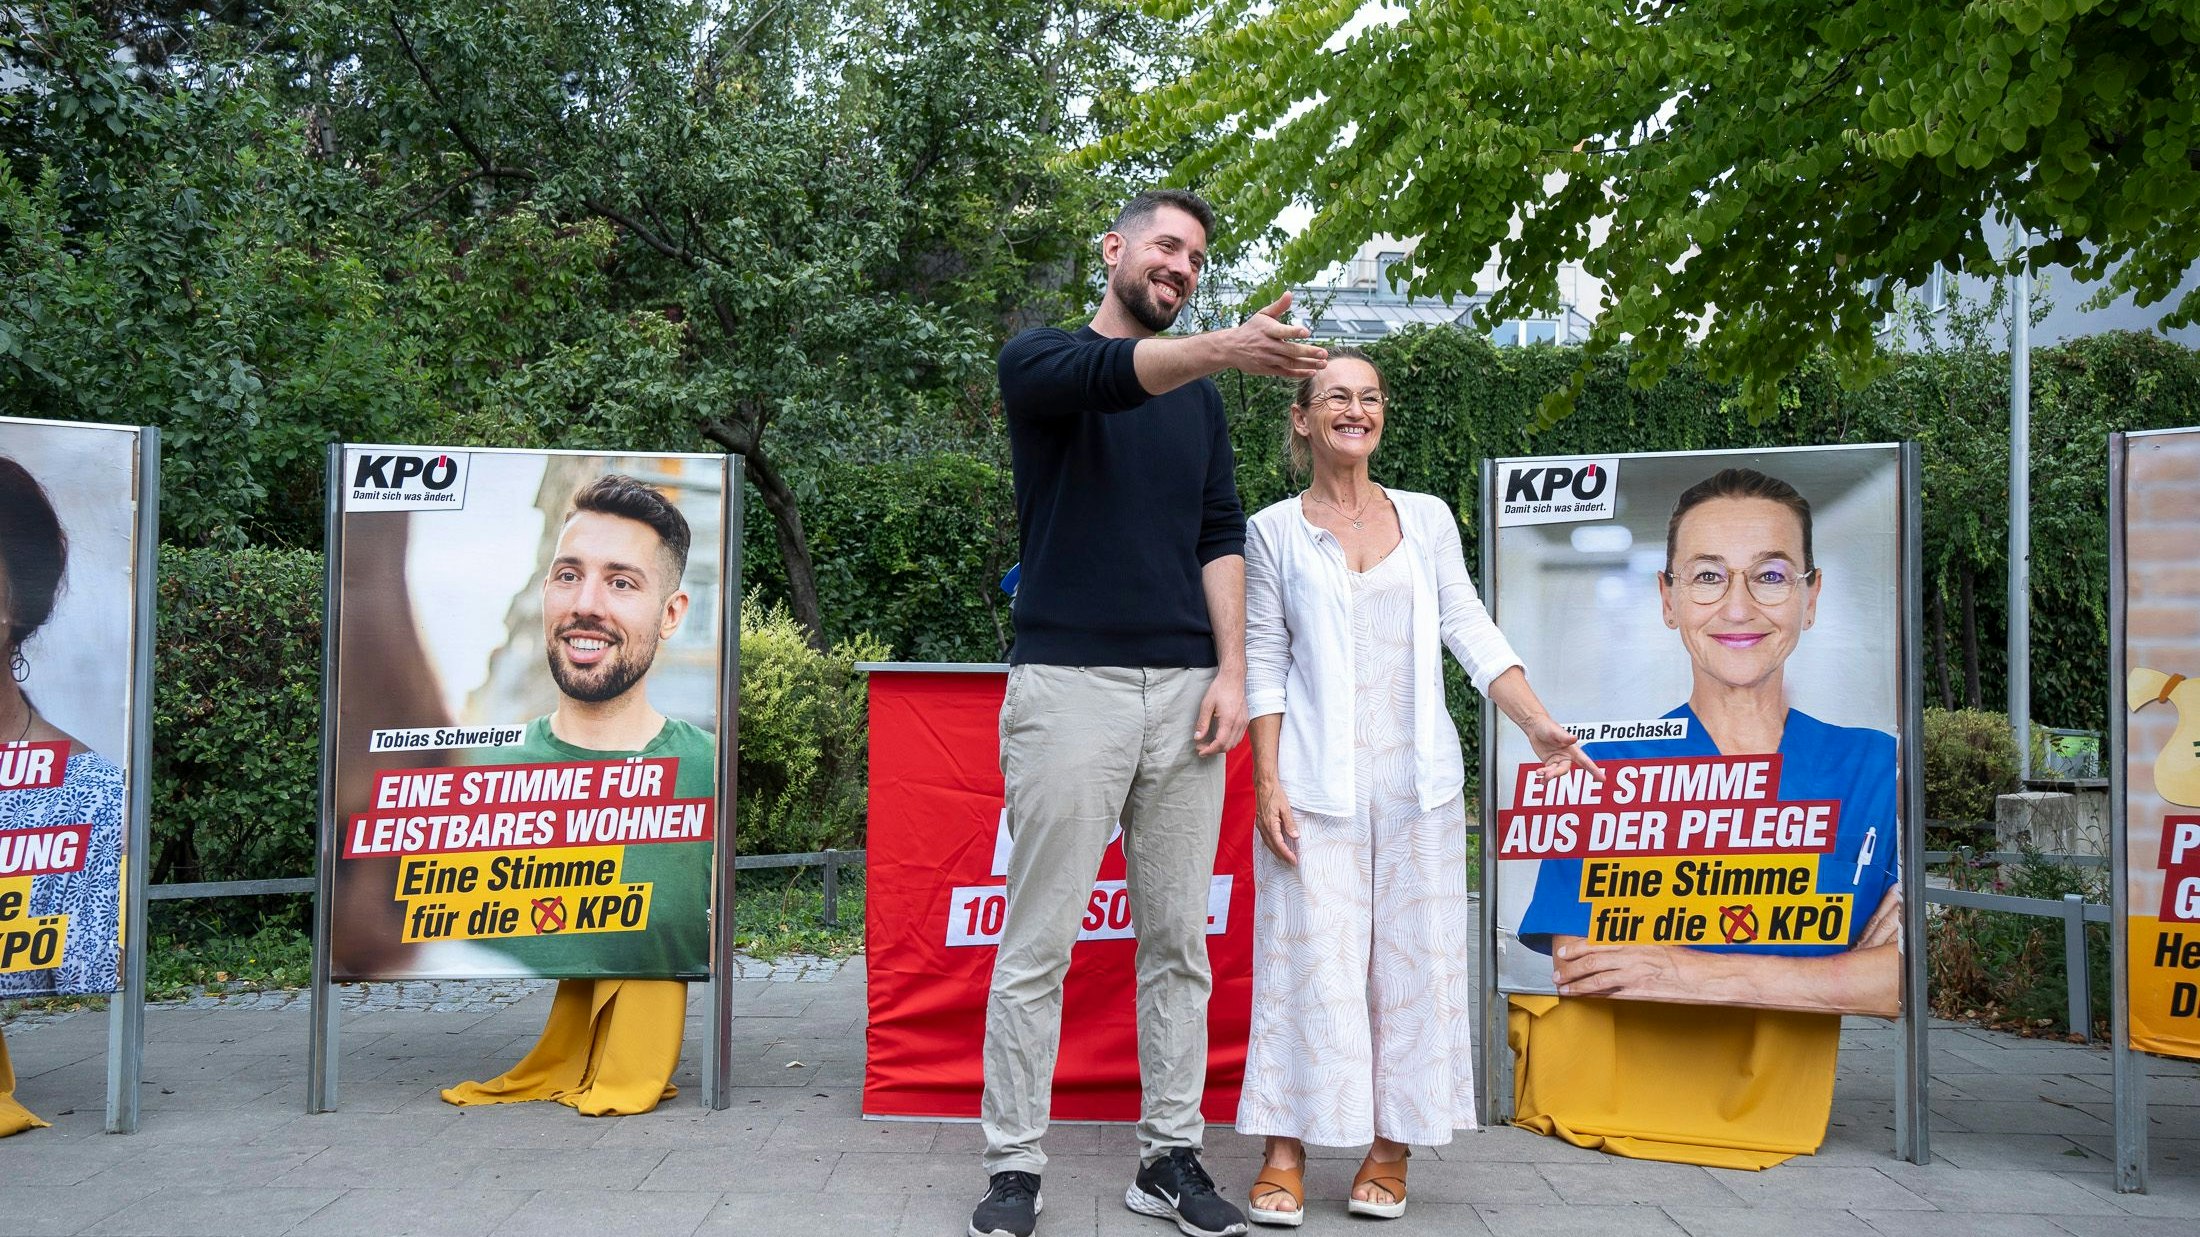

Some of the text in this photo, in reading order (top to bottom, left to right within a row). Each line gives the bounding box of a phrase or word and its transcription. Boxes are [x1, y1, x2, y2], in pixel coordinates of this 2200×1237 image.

[352, 490, 456, 502] Damit sich was ändert.
[1504, 502, 1607, 514] Damit sich was ändert.
[376, 728, 522, 748] Tobias Schweiger
[1600, 721, 1683, 739] Prochaska
[0, 740, 55, 787] ÜR
[376, 757, 664, 809] EINE STIMME FÜR
[1522, 762, 1770, 807] EINE STIMME
[351, 804, 706, 854] LEISTBARES WOHNEN
[1501, 806, 1831, 853] AUS DER PFLEGE
[0, 831, 79, 874] UNG
[402, 856, 616, 896] Eine Stimme
[1586, 860, 1811, 898] Eine Stimme
[411, 885, 645, 939] für die KPÖ
[1596, 896, 1844, 942] für die KPÖ
[0, 917, 59, 968] PÖ
